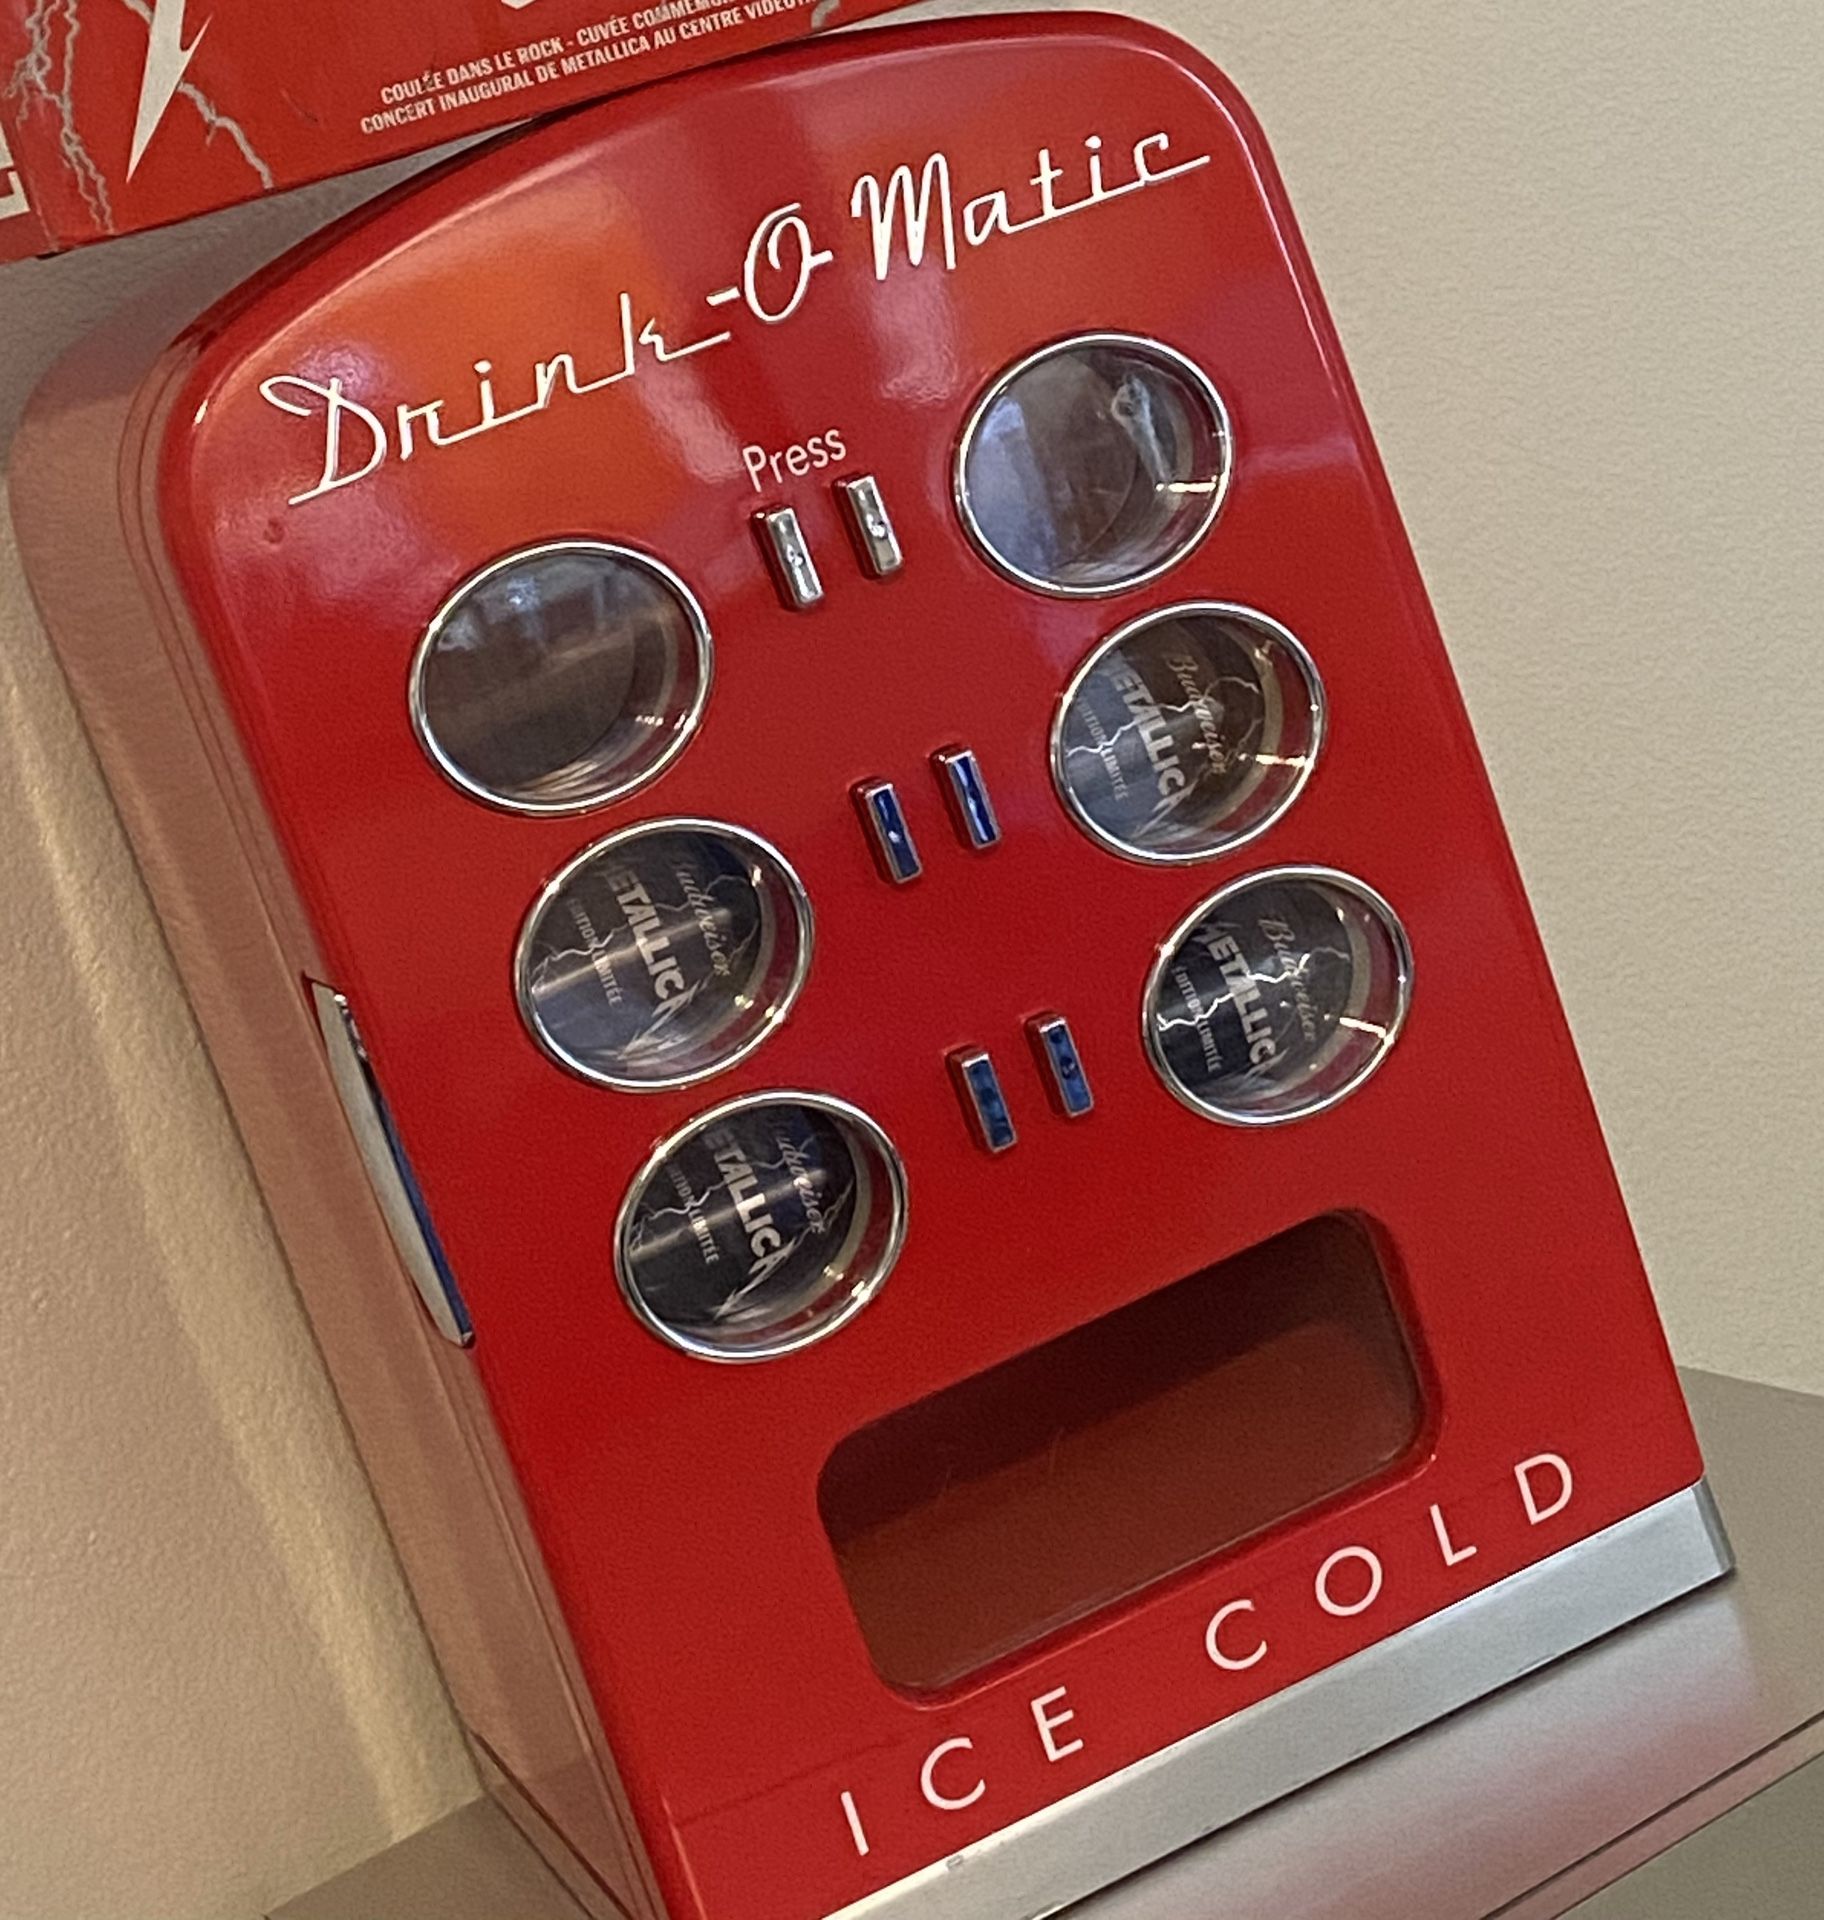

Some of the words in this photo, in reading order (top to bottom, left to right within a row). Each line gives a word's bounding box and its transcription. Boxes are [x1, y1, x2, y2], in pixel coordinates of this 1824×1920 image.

[360, 101, 436, 135] CONCERT
[439, 72, 534, 112] INAUGURAL
[536, 61, 561, 84] DE
[560, 35, 651, 77] METALLICA
[653, 29, 677, 50] AU
[679, 9, 744, 41] CENTRE
[380, 70, 443, 105] COULÉE
[446, 57, 494, 86] DANS
[494, 50, 516, 71] LE
[515, 37, 565, 66] ROCK
[576, 15, 632, 47] CUVÉE
[742, 428, 847, 493] Press
[599, 862, 701, 1058] ETALLICA
[673, 860, 732, 978] udweiser
[700, 1124, 798, 1321] ETALLICA
[768, 1122, 826, 1235] udweiser
[839, 1686, 1084, 1856] ICE
[1205, 1452, 1574, 1671] COLD
